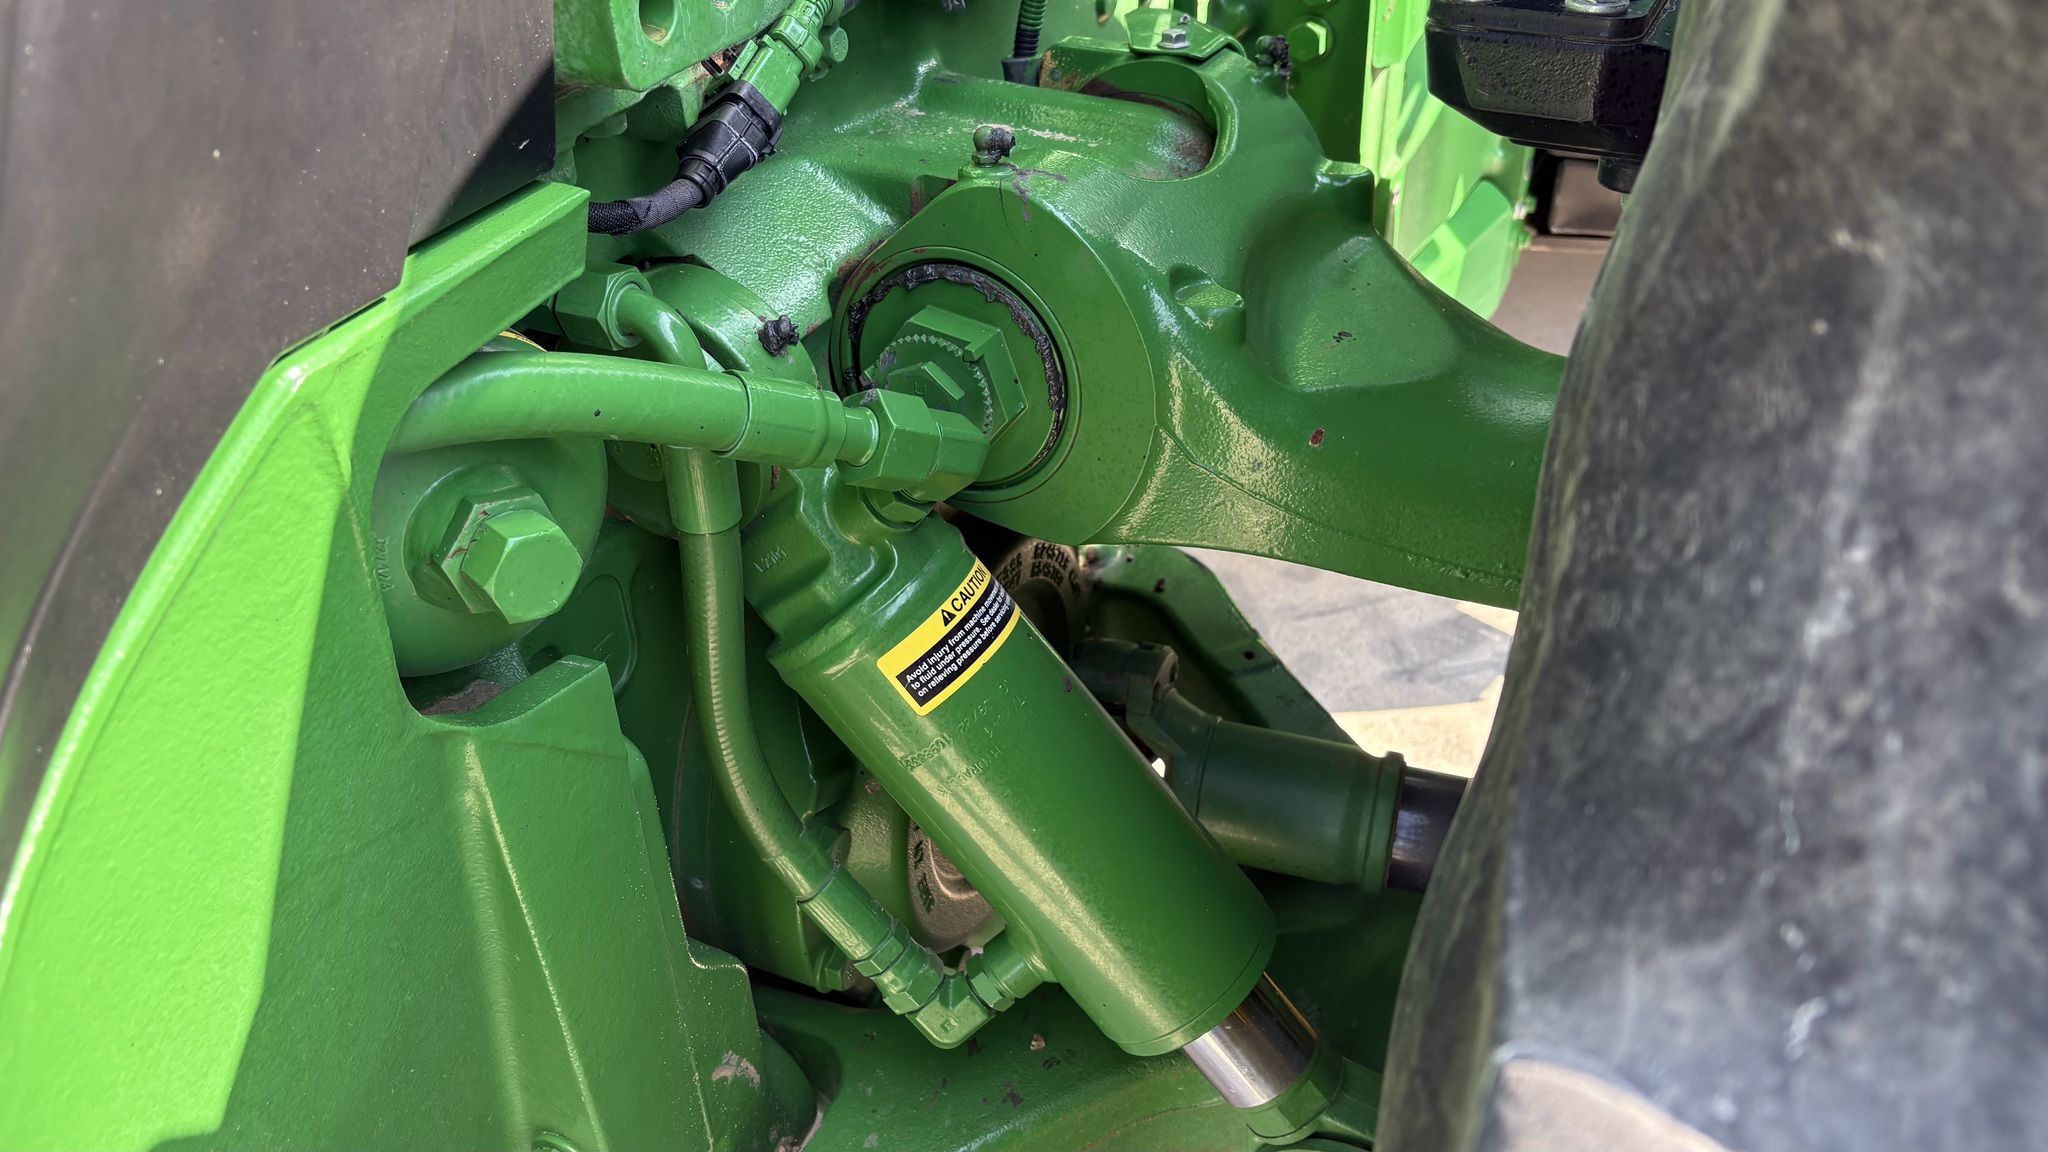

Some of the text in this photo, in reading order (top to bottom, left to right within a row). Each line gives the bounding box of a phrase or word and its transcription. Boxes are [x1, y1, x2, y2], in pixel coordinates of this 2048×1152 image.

[951, 564, 987, 612] CAUTION
[905, 661, 929, 683] Avoid
[928, 643, 951, 667] injury
[948, 629, 966, 648] from
[964, 606, 987, 633] machine
[911, 680, 921, 691] to
[919, 668, 937, 686] fluid
[937, 652, 956, 671] under
[954, 627, 983, 654] pressure.
[979, 613, 991, 627] See
[917, 685, 929, 698] on
[927, 662, 959, 691] relieving
[955, 637, 983, 667] pressure
[980, 621, 997, 642] before
